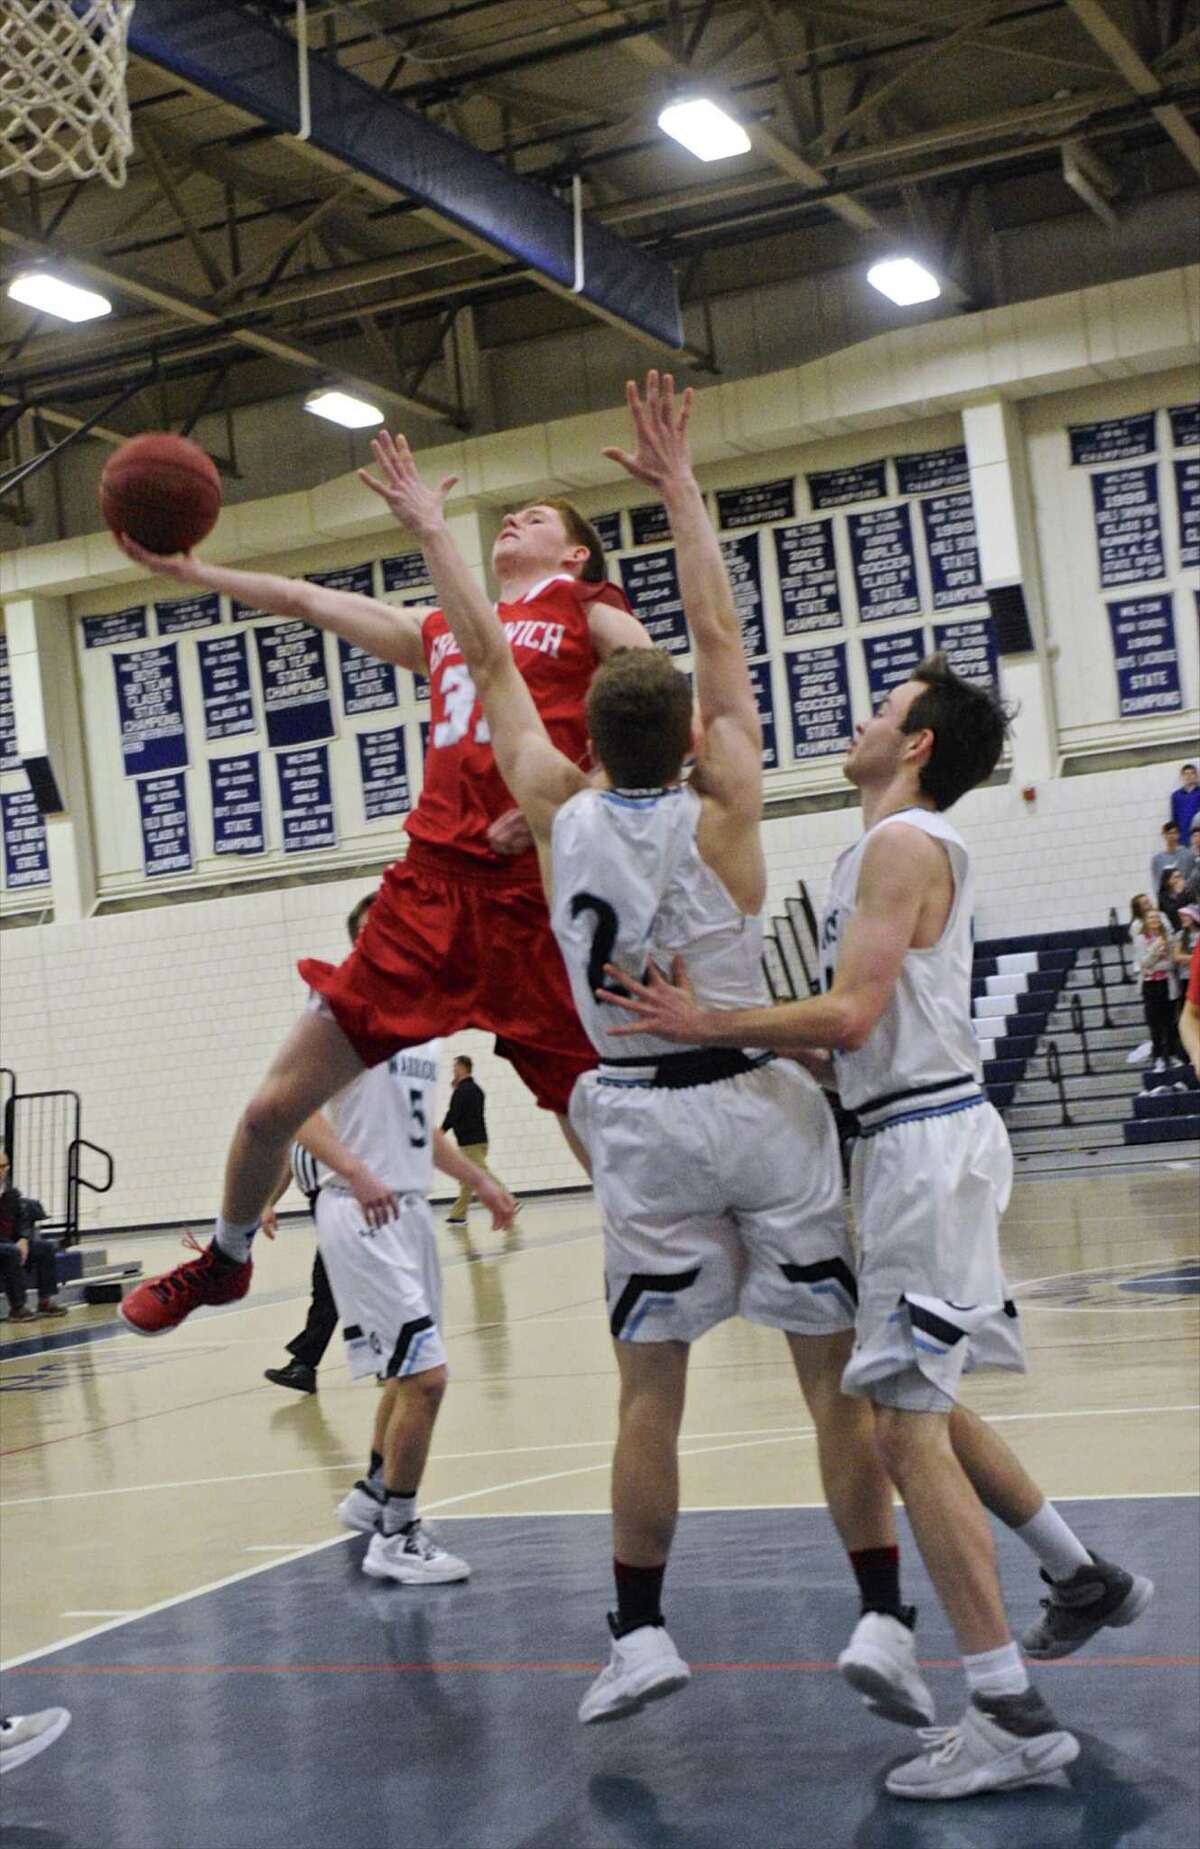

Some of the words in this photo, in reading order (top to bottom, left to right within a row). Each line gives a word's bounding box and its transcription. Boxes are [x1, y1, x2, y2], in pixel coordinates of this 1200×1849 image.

[858, 555, 912, 576] SOCCER
[1130, 670, 1168, 690] STATE
[433, 664, 491, 749] 3
[794, 694, 847, 714] SOCCER
[409, 1088, 427, 1148] 5
